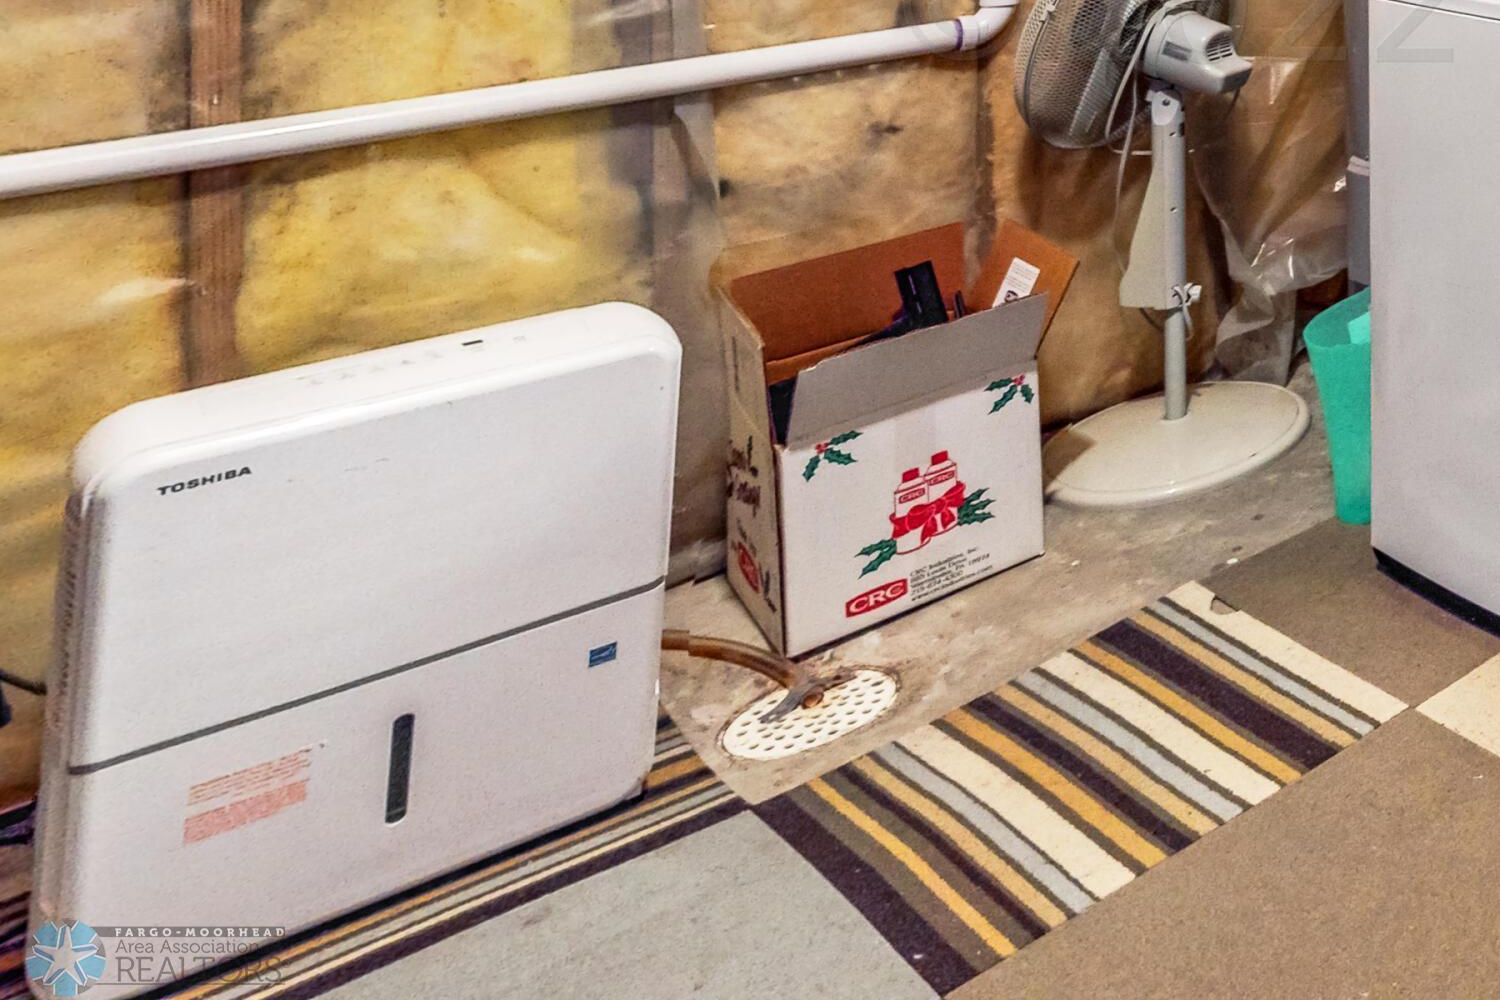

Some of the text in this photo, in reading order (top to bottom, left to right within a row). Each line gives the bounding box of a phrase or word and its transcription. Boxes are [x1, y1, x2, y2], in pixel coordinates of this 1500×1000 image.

[157, 466, 252, 496] TOSHIBA
[900, 490, 924, 503] CRC
[849, 583, 905, 613] CRC
